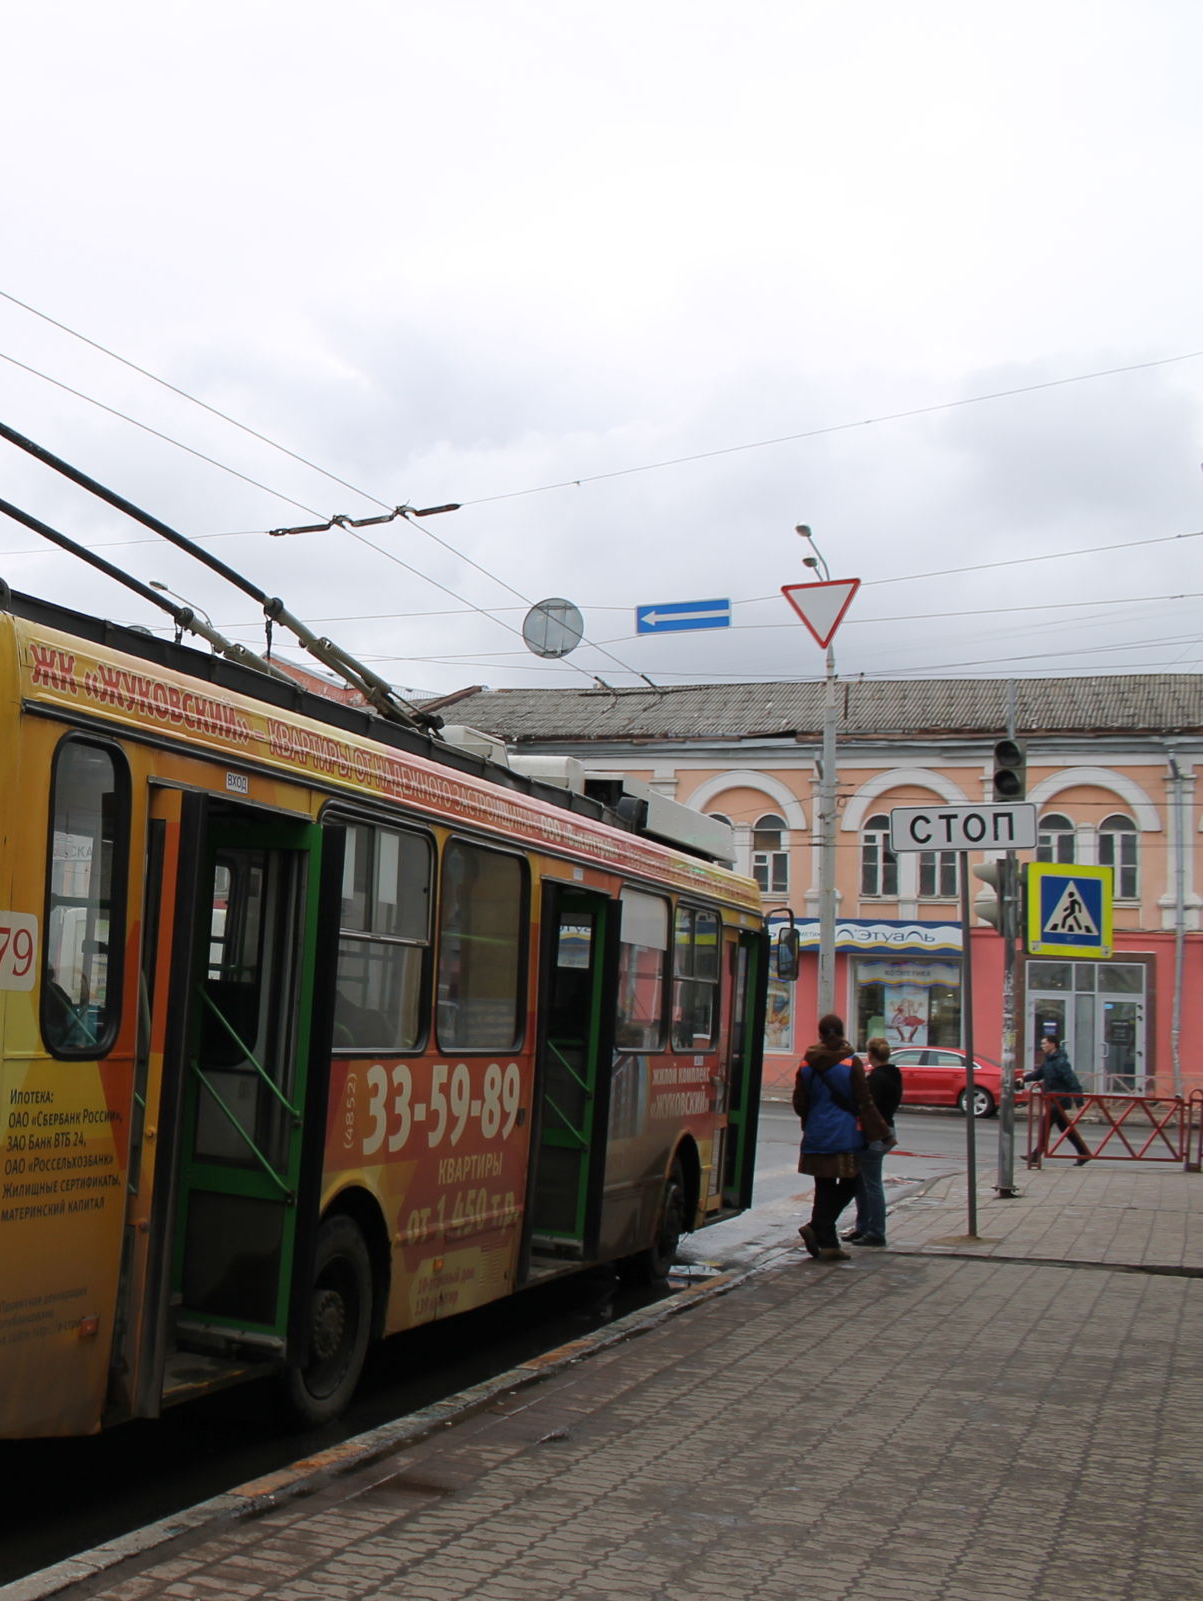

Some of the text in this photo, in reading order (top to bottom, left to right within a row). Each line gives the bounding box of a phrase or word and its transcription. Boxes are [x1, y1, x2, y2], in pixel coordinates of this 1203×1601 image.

[29, 644, 78, 697] ЖК
[84, 664, 251, 745] «ЖУКОВСКИЙ»
[267, 718, 352, 778] КВАРТИРЫ
[354, 748, 373, 785] ОТ
[228, 774, 247, 792] ВХОД
[910, 812, 1014, 844] СТОП
[8, 1111, 29, 1129] ОАО
[343, 1063, 520, 1155] (4852) 33-59-89
[6, 1135, 26, 1152] ЗАО
[54, 1132, 71, 1148] ВТБ
[73, 1131, 86, 1149] 24,
[5, 1157, 26, 1175] ОАО
[438, 1152, 504, 1185] КВАРТИРЫ
